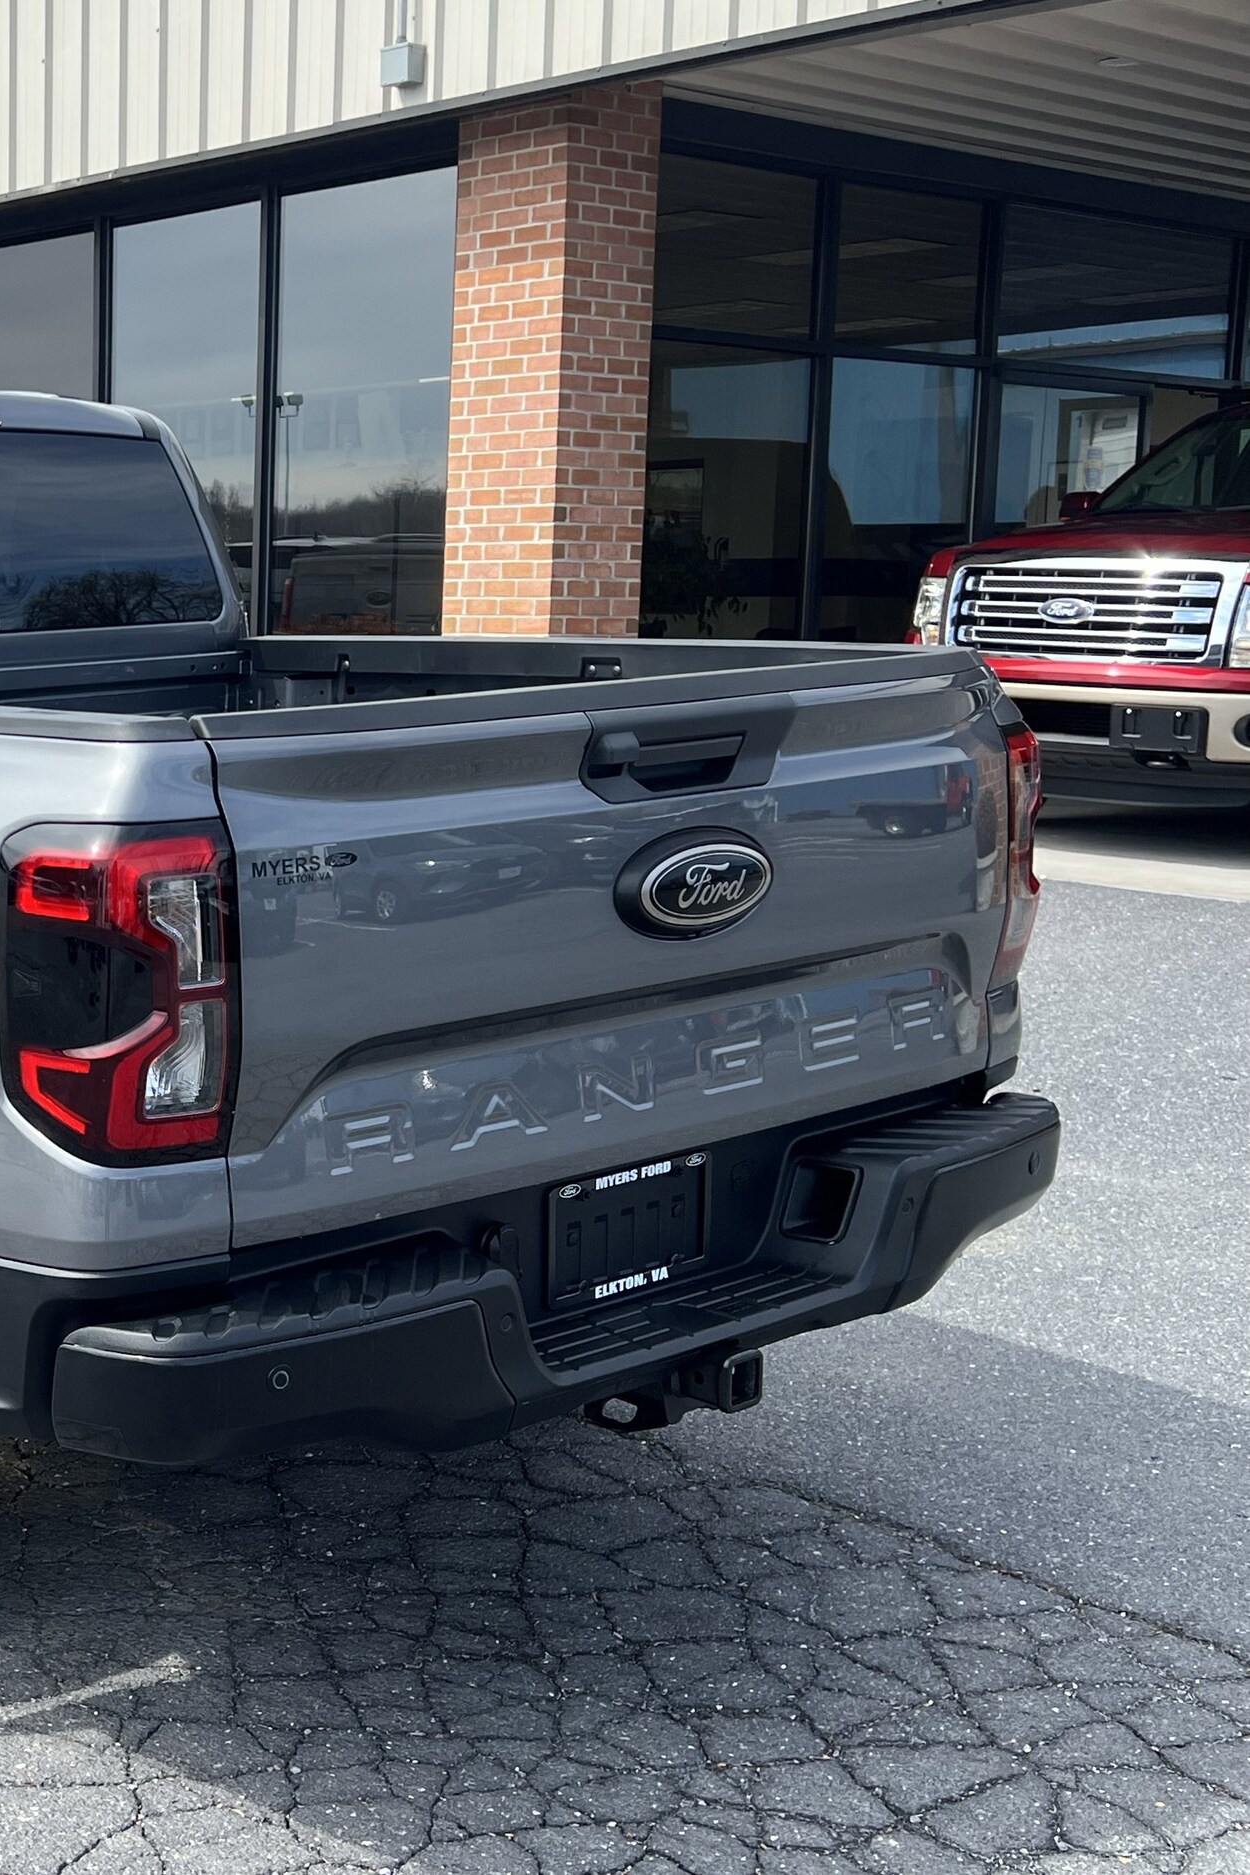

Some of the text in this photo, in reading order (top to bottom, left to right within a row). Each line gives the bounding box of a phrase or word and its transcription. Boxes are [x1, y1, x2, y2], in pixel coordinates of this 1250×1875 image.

[1046, 601, 1079, 617] Ford
[251, 855, 321, 878] MYERS
[319, 871, 332, 881] VA
[678, 862, 747, 909] Ford
[328, 993, 948, 1176] RANGER
[595, 1160, 672, 1191] MYERS FORD
[595, 1266, 669, 1299] ELKTON, VA
